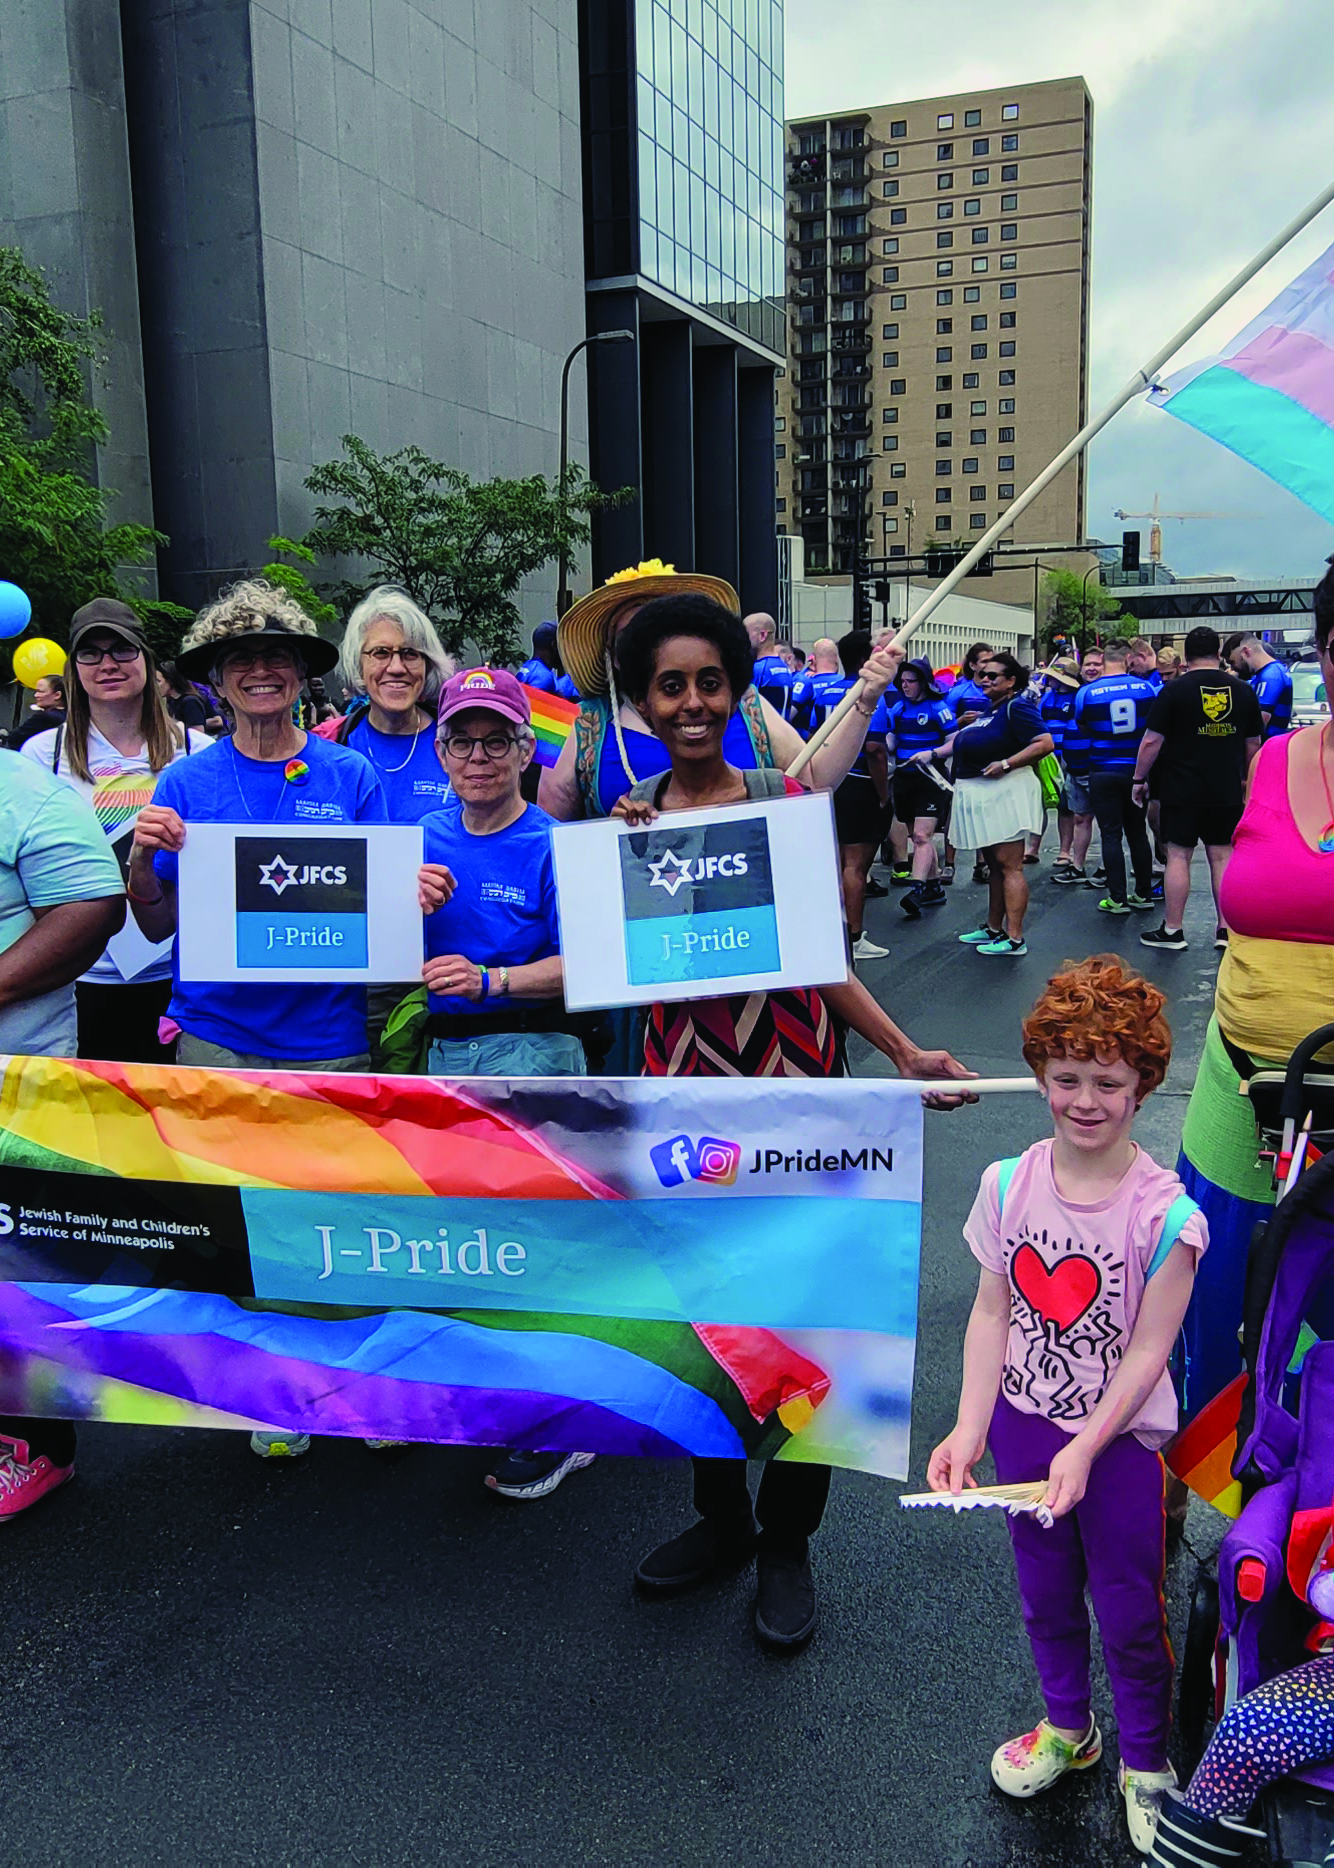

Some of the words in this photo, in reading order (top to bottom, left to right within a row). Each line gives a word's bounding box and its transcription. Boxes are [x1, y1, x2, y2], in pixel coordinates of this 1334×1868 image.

[1109, 698, 1136, 734] 9
[299, 865, 347, 885] JFCS
[695, 853, 748, 880] JFCS
[266, 926, 344, 950] J-Pride
[661, 926, 750, 961] J-Pride
[749, 1148, 894, 1173] JPrideMN
[19, 1206, 62, 1222] Jewish
[65, 1211, 108, 1229] Family
[112, 1218, 138, 1230] and
[141, 1219, 211, 1236] Children's
[19, 1223, 69, 1239] Service
[72, 1229, 87, 1241] of
[91, 1231, 175, 1250] Minneapolis
[314, 1225, 526, 1280] J-Pride
